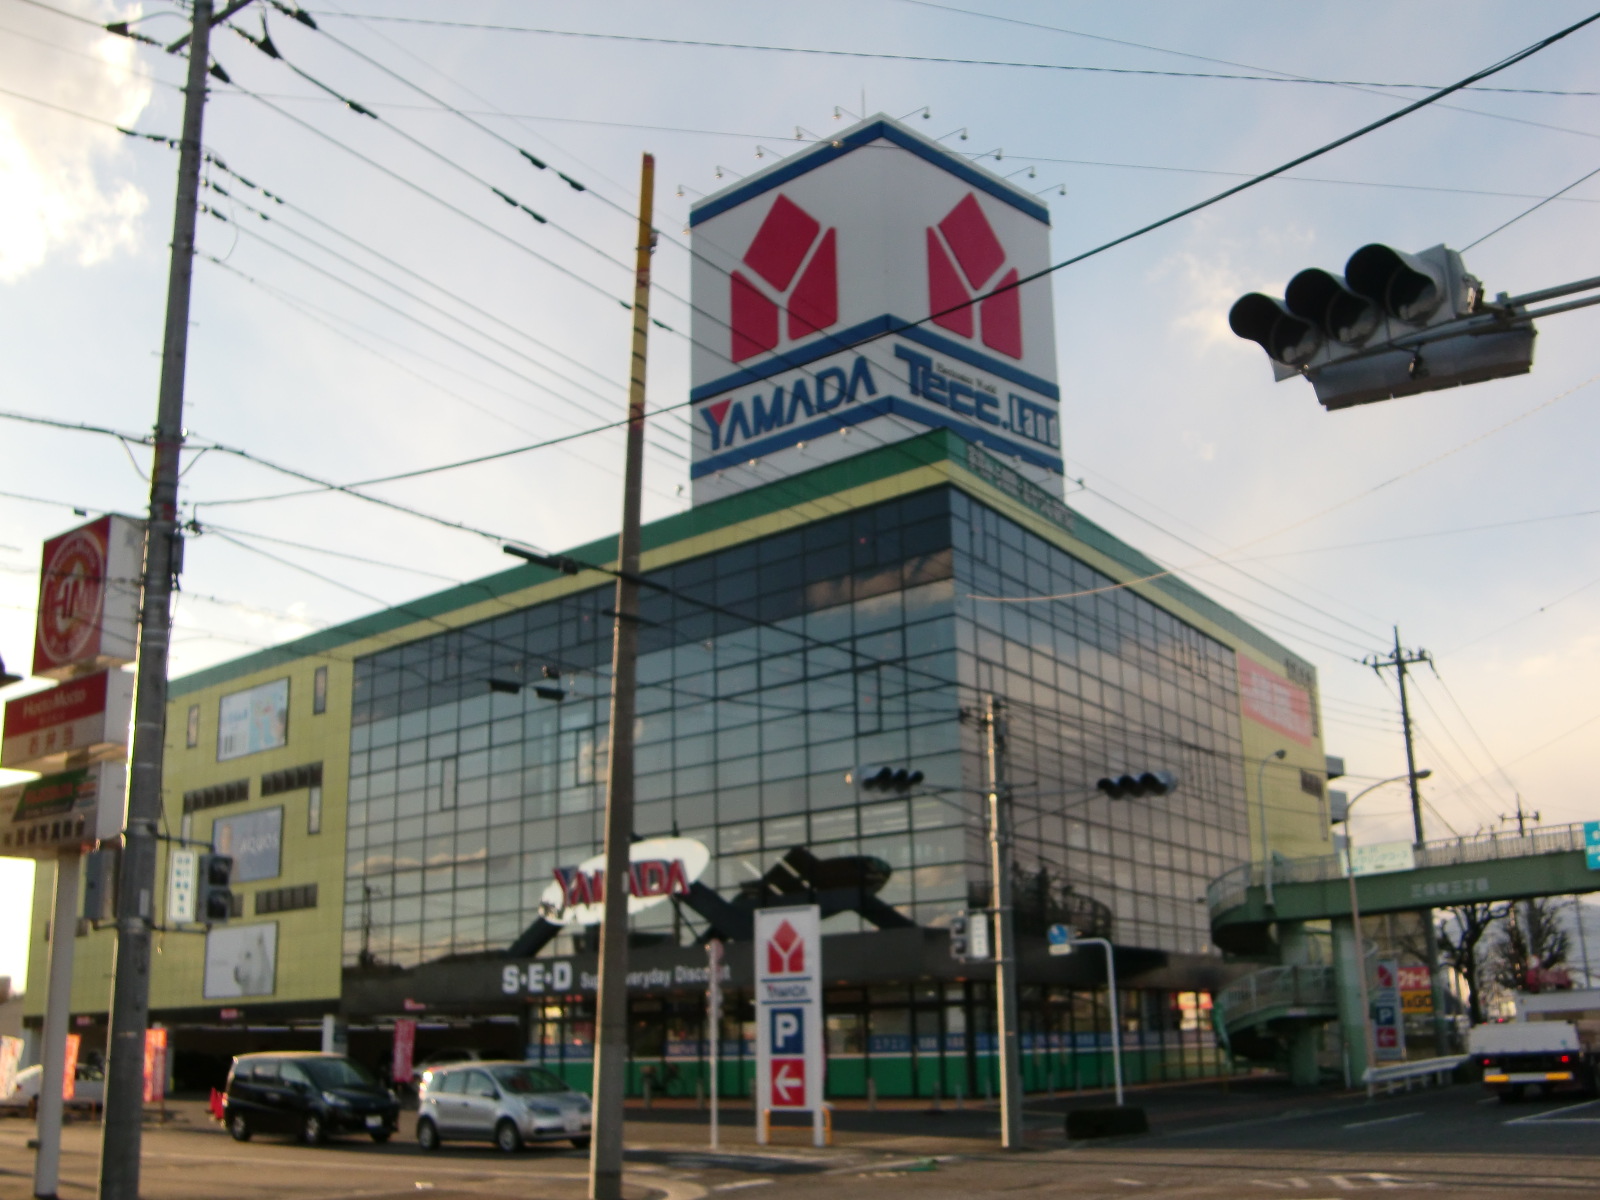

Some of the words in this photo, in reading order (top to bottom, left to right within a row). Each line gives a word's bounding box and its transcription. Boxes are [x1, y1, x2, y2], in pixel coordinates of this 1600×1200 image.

[700, 355, 877, 451] YAMADA
[625, 968, 672, 988] veryday
[775, 1013, 799, 1048] P
